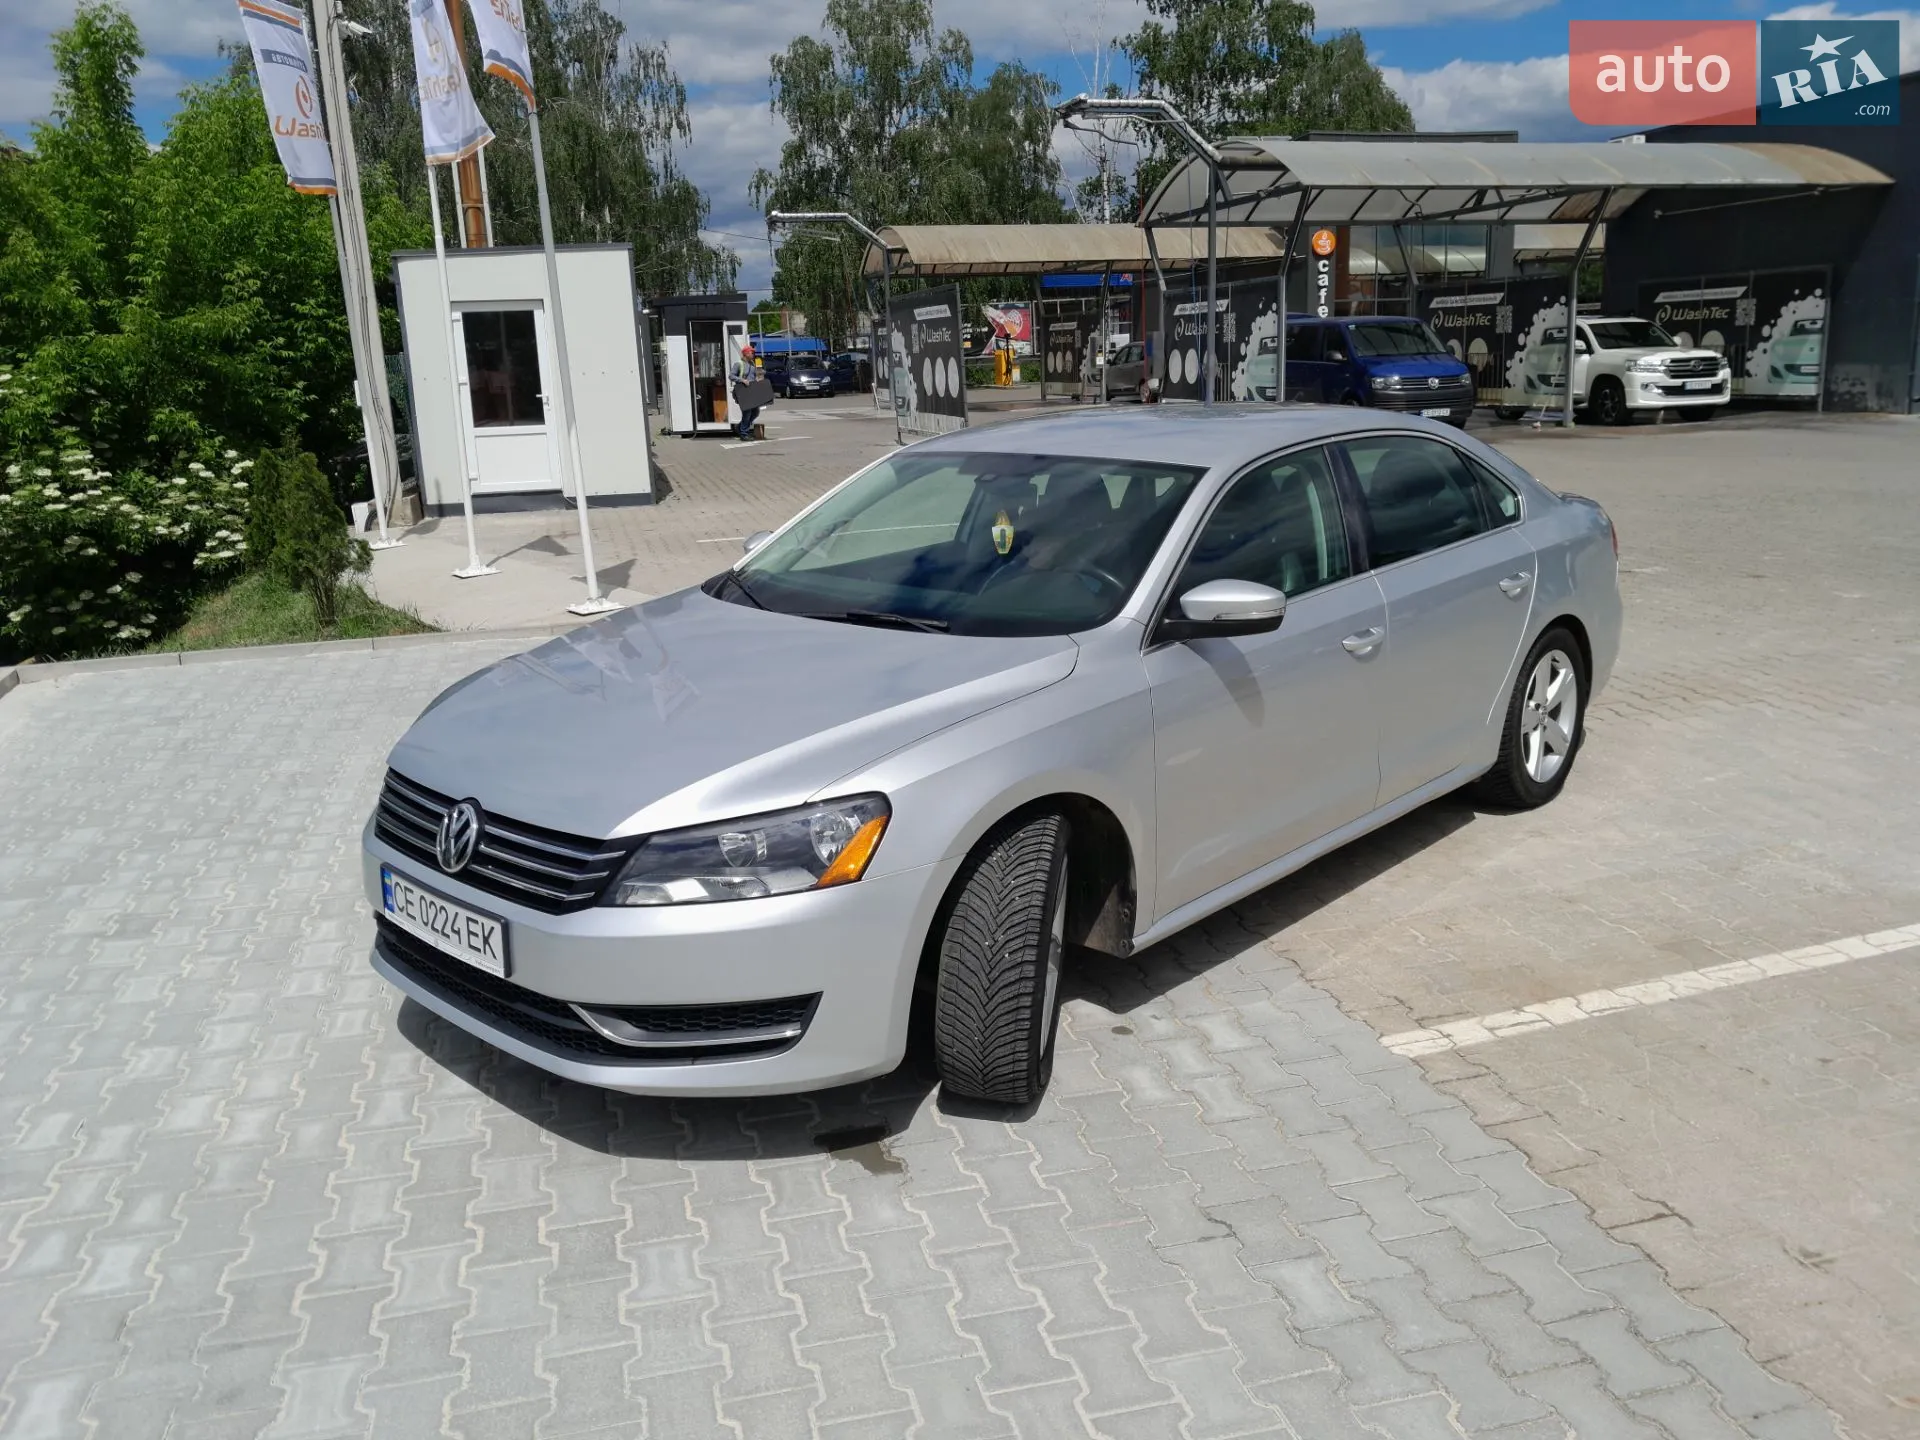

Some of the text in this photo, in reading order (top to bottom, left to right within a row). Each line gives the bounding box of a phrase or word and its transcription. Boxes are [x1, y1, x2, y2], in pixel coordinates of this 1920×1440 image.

[1317, 260, 1329, 318] cafe
[1444, 313, 1491, 327] WashTec
[1672, 307, 1730, 320] WashTec
[394, 881, 498, 960] CE 0224 EK
